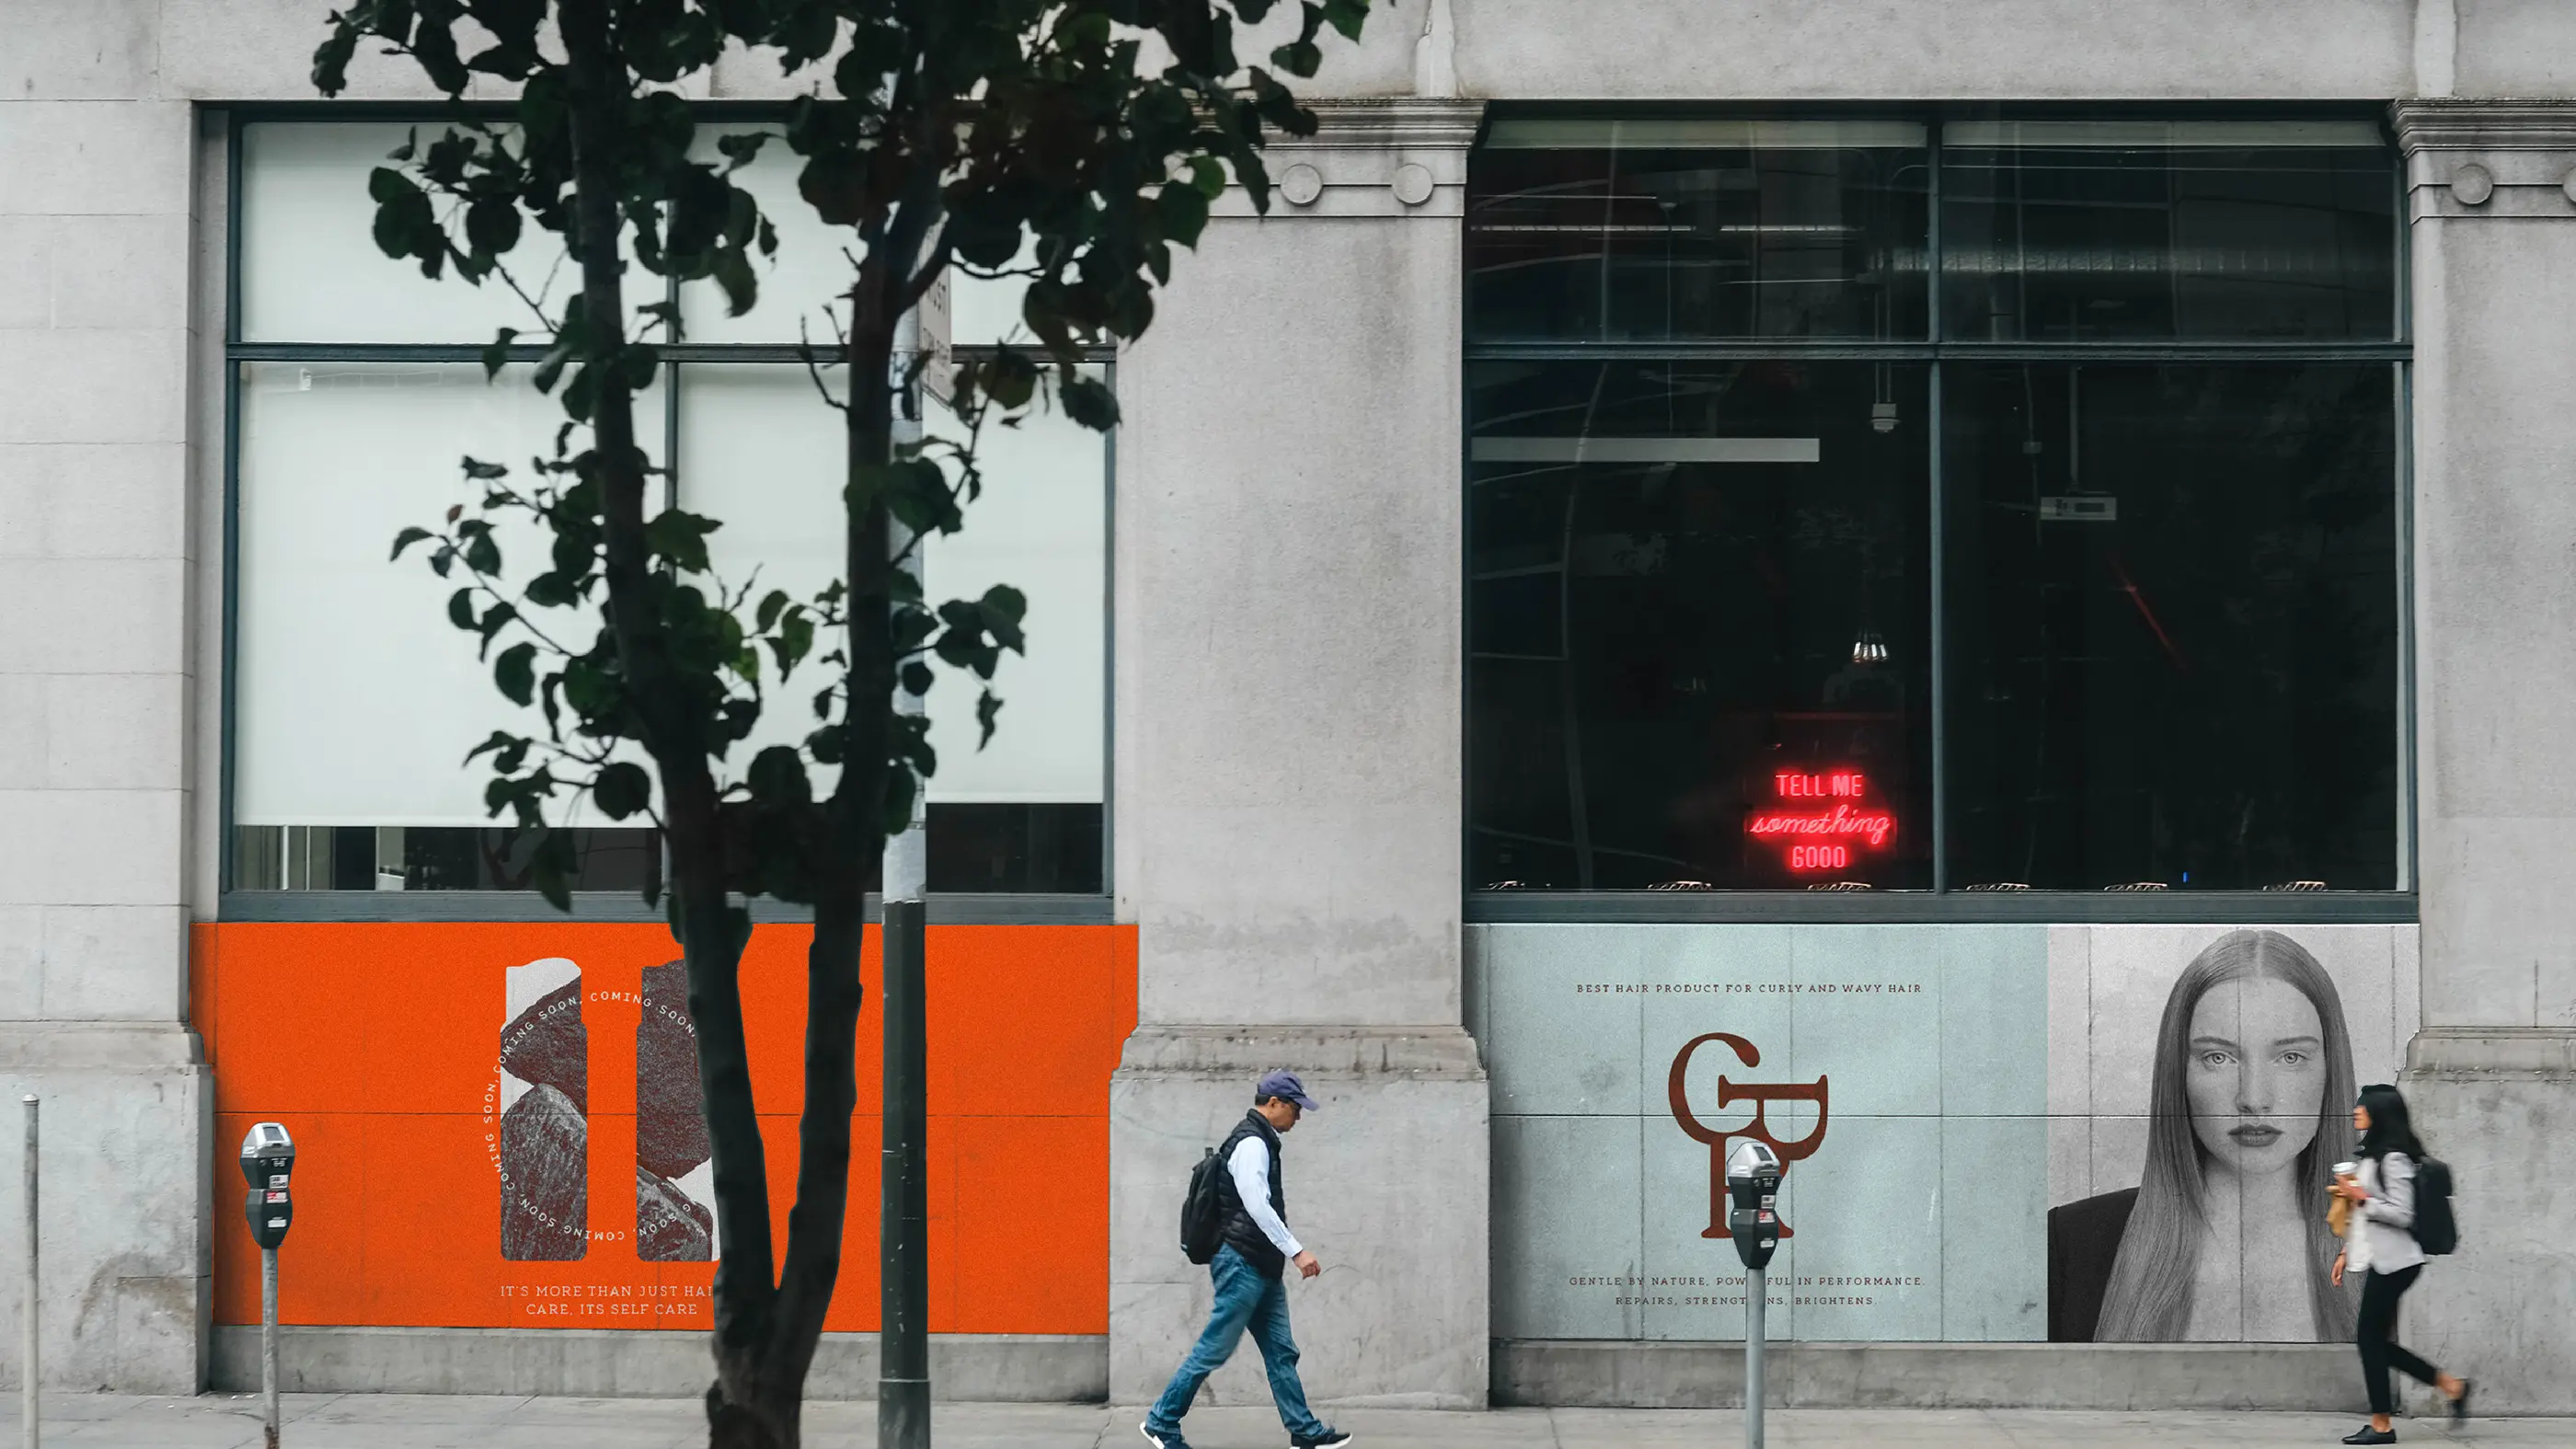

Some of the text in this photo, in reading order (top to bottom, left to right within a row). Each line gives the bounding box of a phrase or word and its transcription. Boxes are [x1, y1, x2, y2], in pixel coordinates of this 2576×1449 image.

[1775, 774, 1863, 797] TELL ME
[1750, 803, 1891, 845] something
[1791, 845, 1846, 868] GOOD
[1577, 983, 1921, 994] BEST HAIR PRODUCT FOR CURLY AND WAVY HAIR
[590, 991, 652, 1007] COMING
[492, 1021, 534, 1074] COMING
[485, 1133, 515, 1190] COMING
[563, 1225, 626, 1241] COMING
[1569, 1277, 1926, 1287] GENTLE BY NATURE, POWFUL IN PERFORMANCE.
[500, 1285, 713, 1297] IT'S MORE THAN JUST HAI
[1616, 1296, 1878, 1306] REPAIRS, STRENGTNS, BRIGHTENS.
[525, 1303, 697, 1316] CARE, ITS SELF CARE
